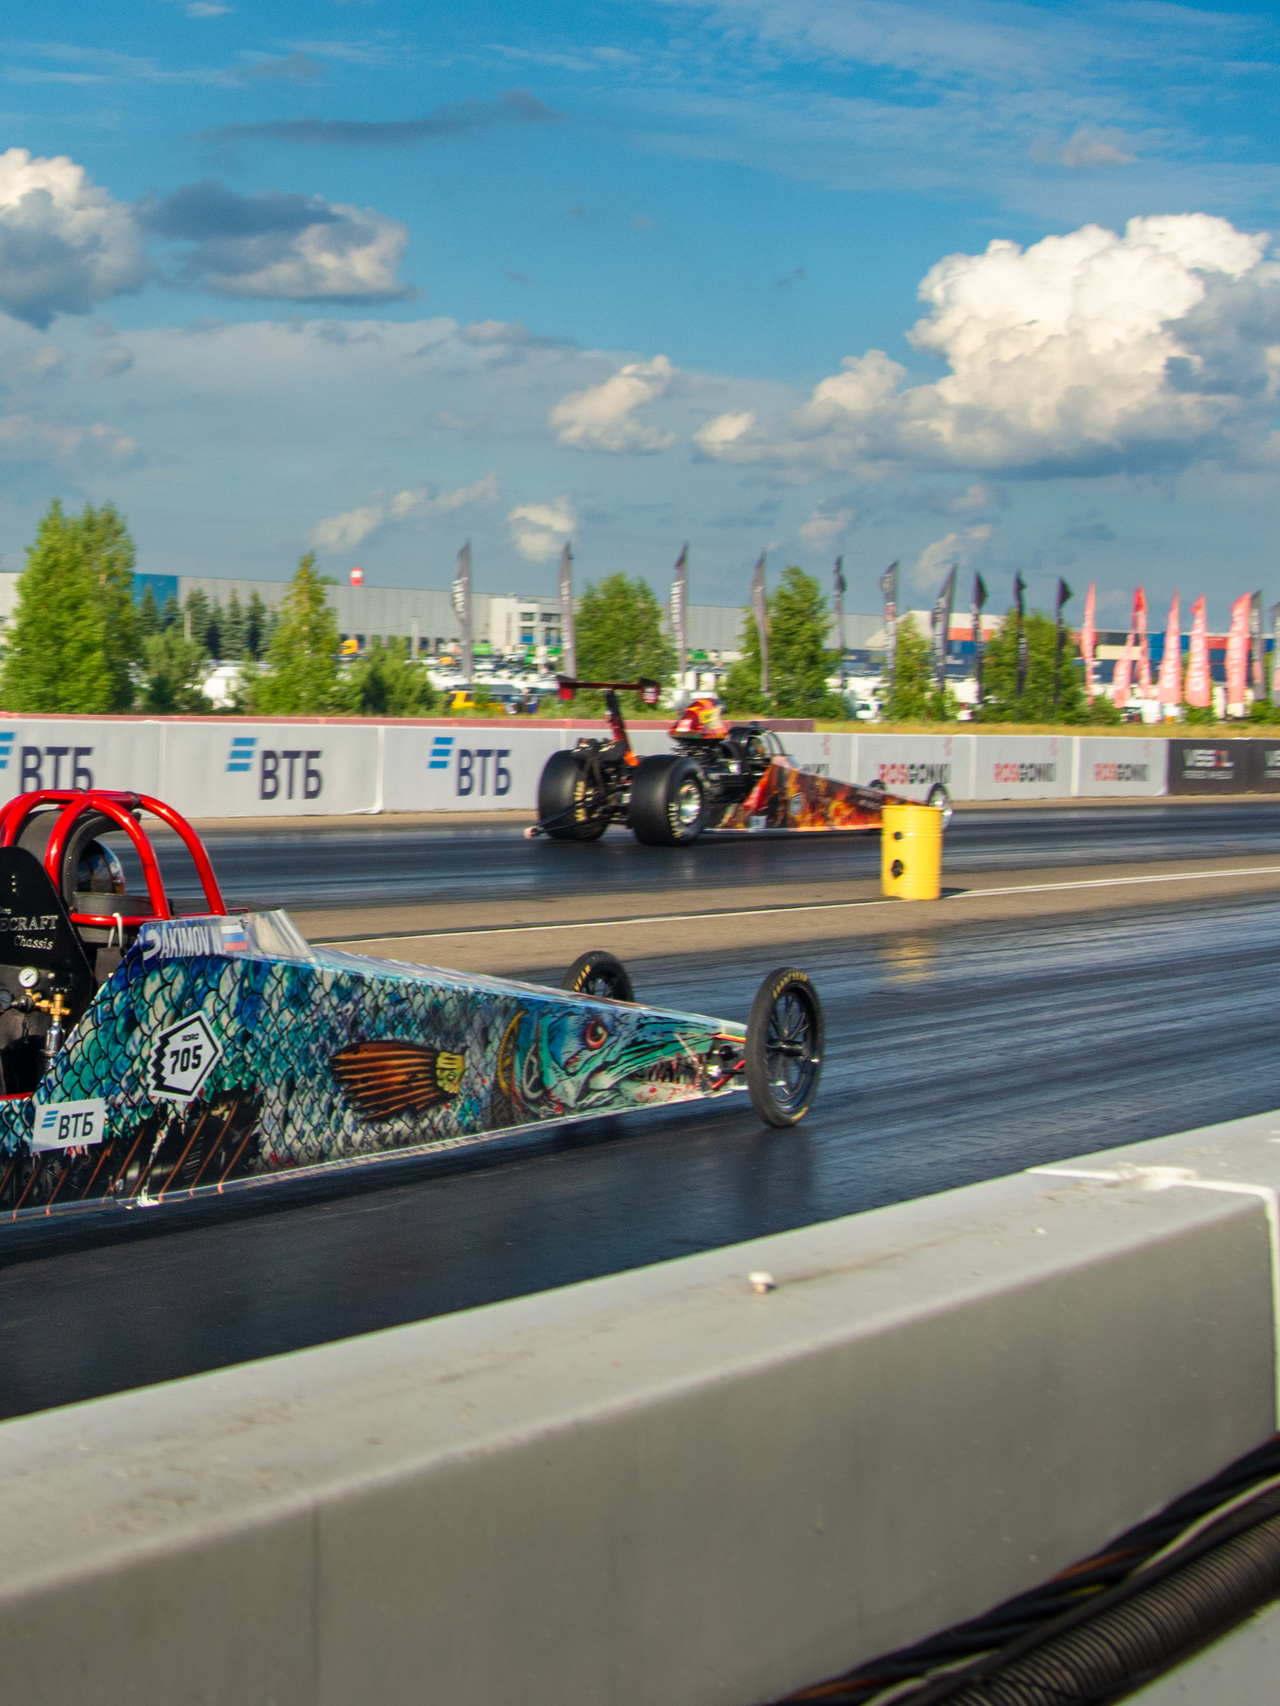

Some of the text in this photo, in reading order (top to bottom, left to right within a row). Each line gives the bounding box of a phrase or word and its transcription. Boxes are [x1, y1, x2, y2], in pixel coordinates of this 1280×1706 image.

[20, 746, 95, 793] ВТБ
[260, 750, 323, 800] ВТБ
[456, 749, 511, 797] ВТБ
[14, 935, 53, 950] Chassis
[160, 926, 210, 959] AKIMOV
[170, 1044, 203, 1075] 705
[58, 1111, 95, 1140] ВТБ
